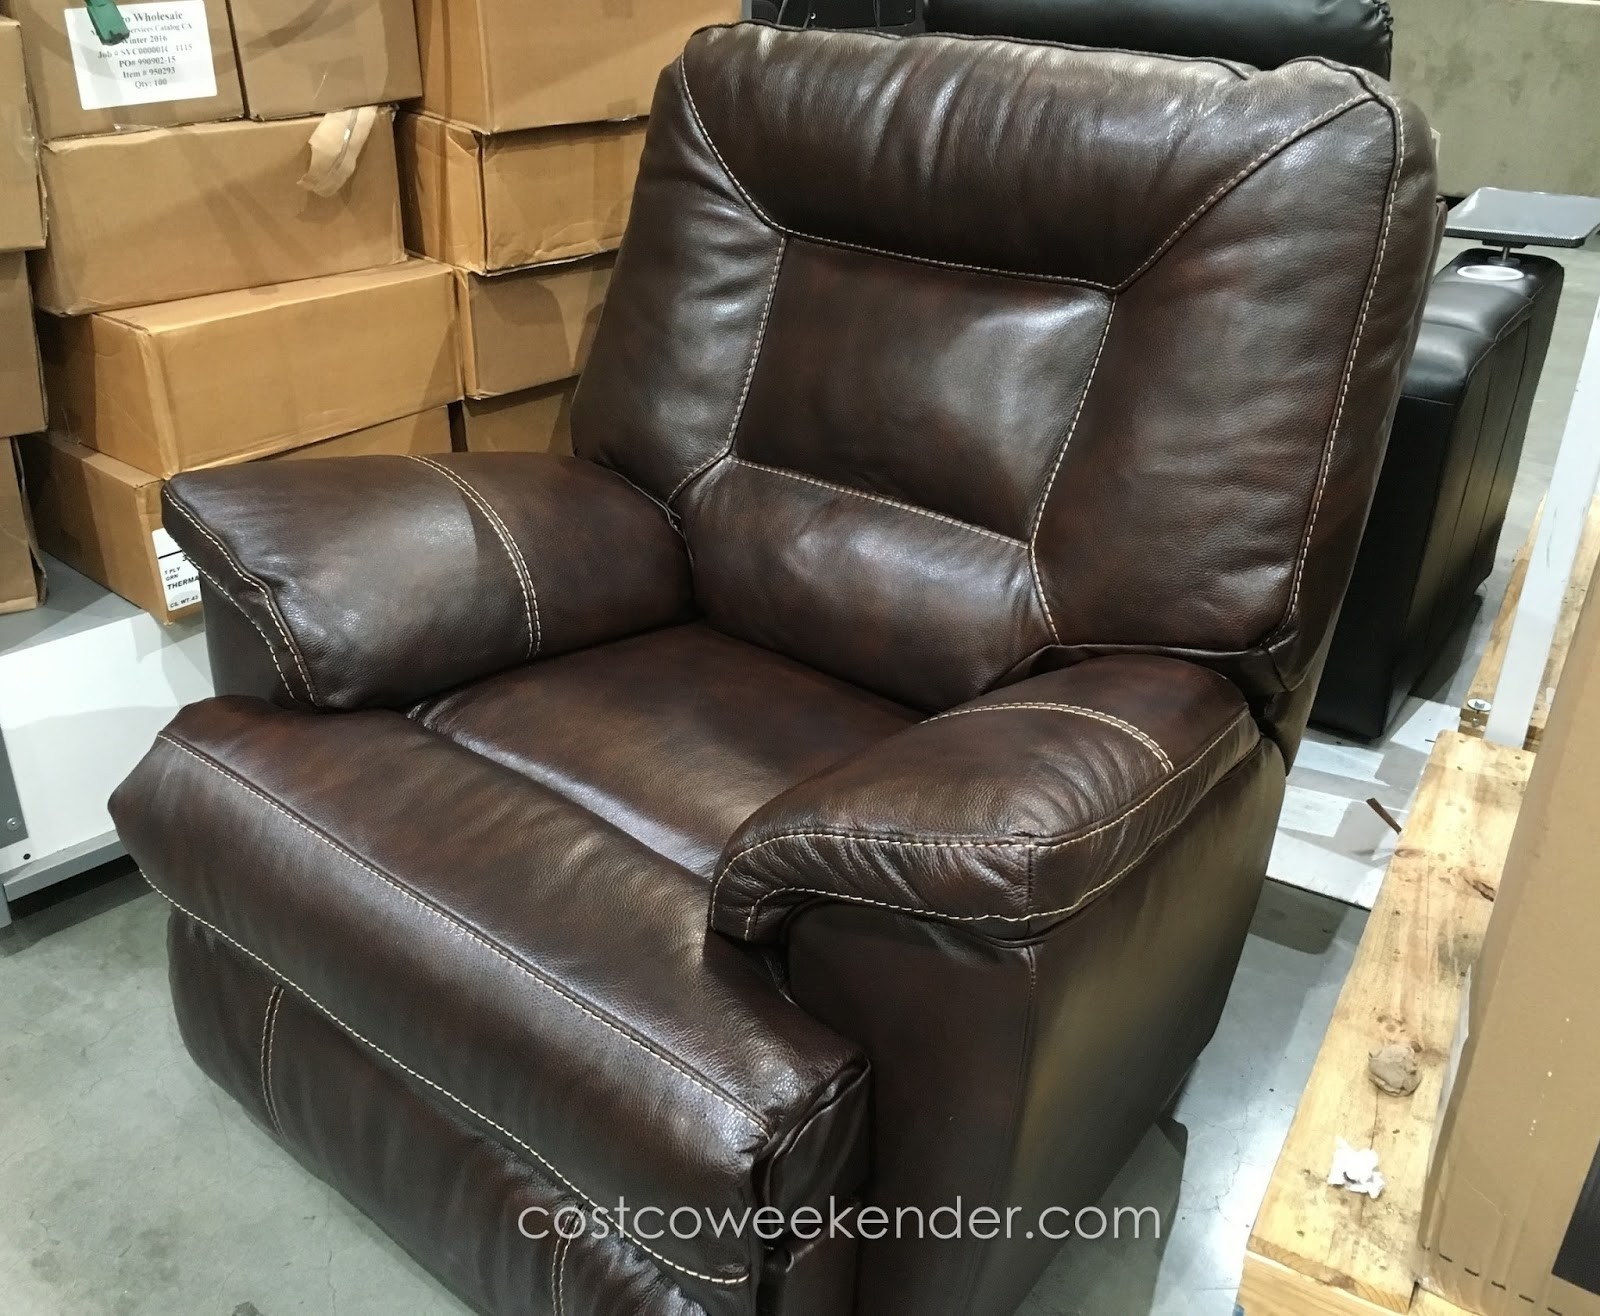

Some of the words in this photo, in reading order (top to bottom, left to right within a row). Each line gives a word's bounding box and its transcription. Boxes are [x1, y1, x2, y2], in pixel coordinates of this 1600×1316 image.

[133, 11, 183, 22] Wholesale
[129, 26, 153, 34] ervices
[150, 35, 168, 43] 2016
[98, 50, 113, 59] Job
[123, 70, 141, 79] Item
[149, 66, 176, 76] 950293
[154, 78, 168, 87] 100
